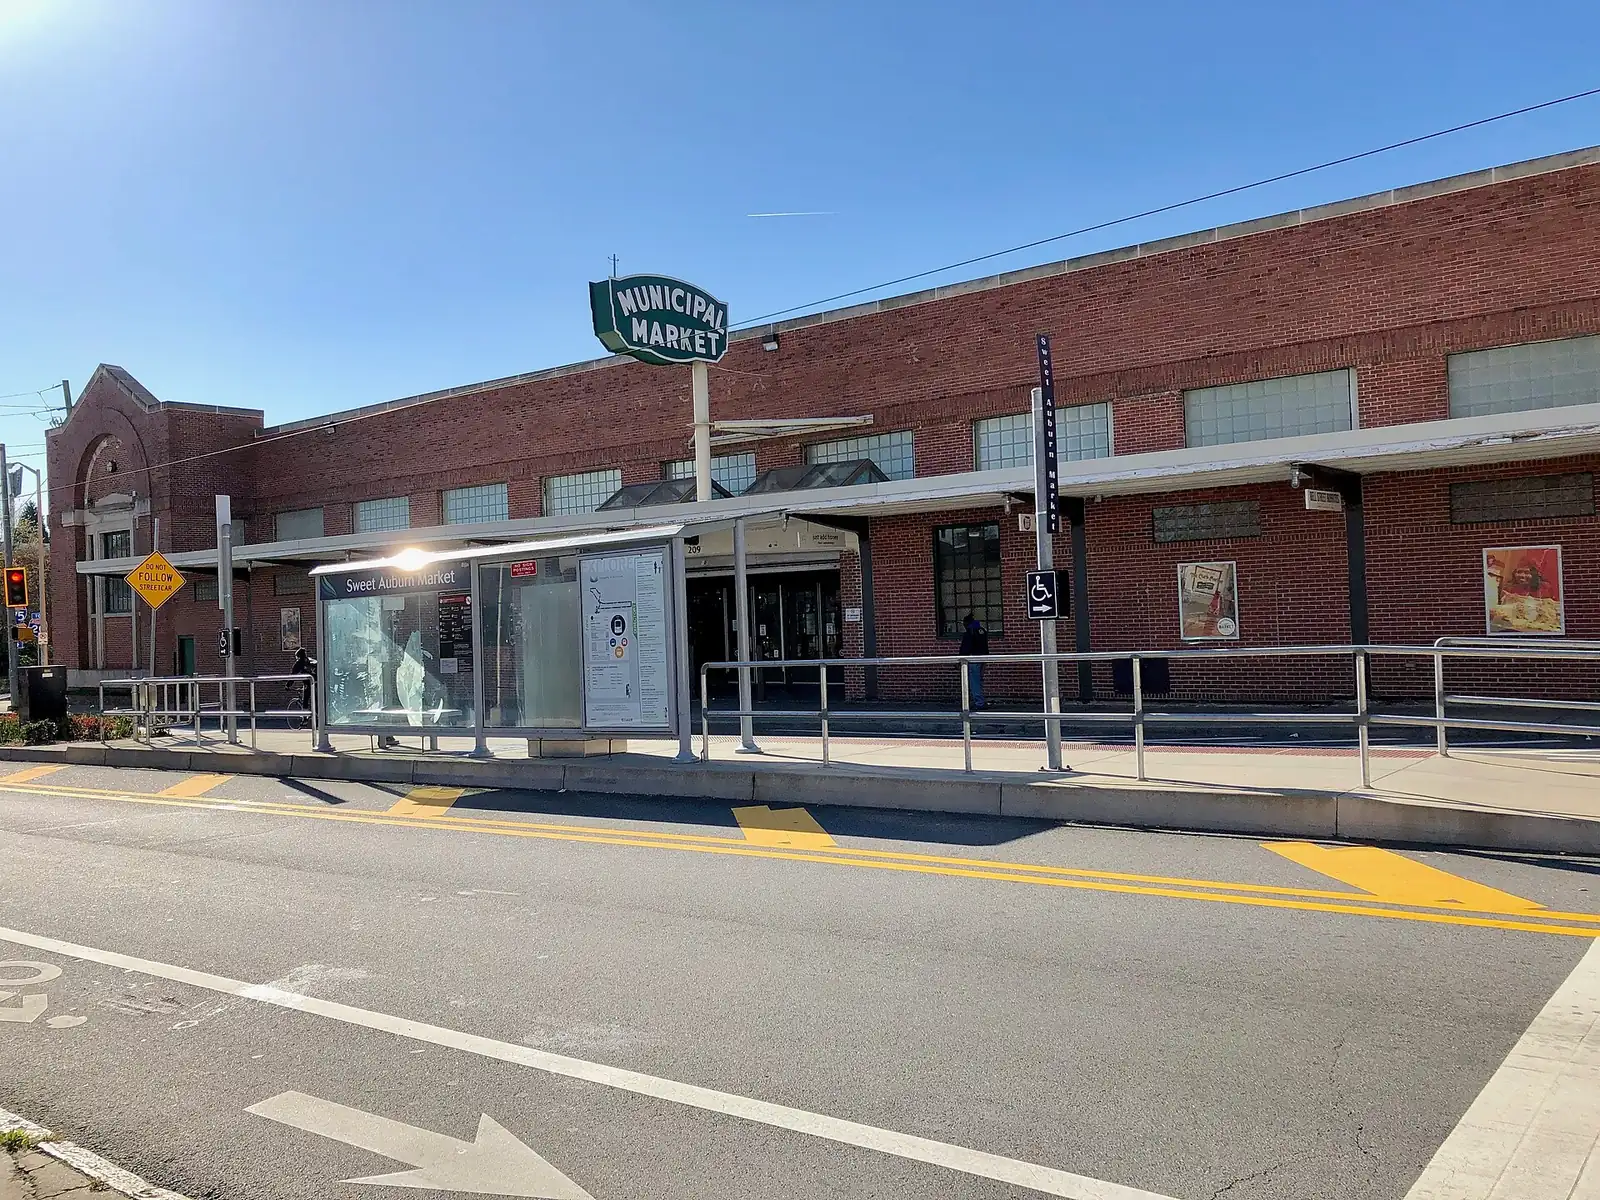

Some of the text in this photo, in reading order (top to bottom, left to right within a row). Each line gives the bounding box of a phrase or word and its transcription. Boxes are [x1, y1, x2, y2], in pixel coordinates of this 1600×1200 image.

[616, 284, 725, 335] MUNICIPAL
[632, 317, 720, 356] MARKET
[1040, 338, 1056, 530] Sweet Auburn Market
[687, 545, 701, 554] 209
[138, 572, 174, 583] FOLLOW
[139, 583, 173, 592] STREETCAR
[345, 570, 456, 593] Sweet Auburn Market
